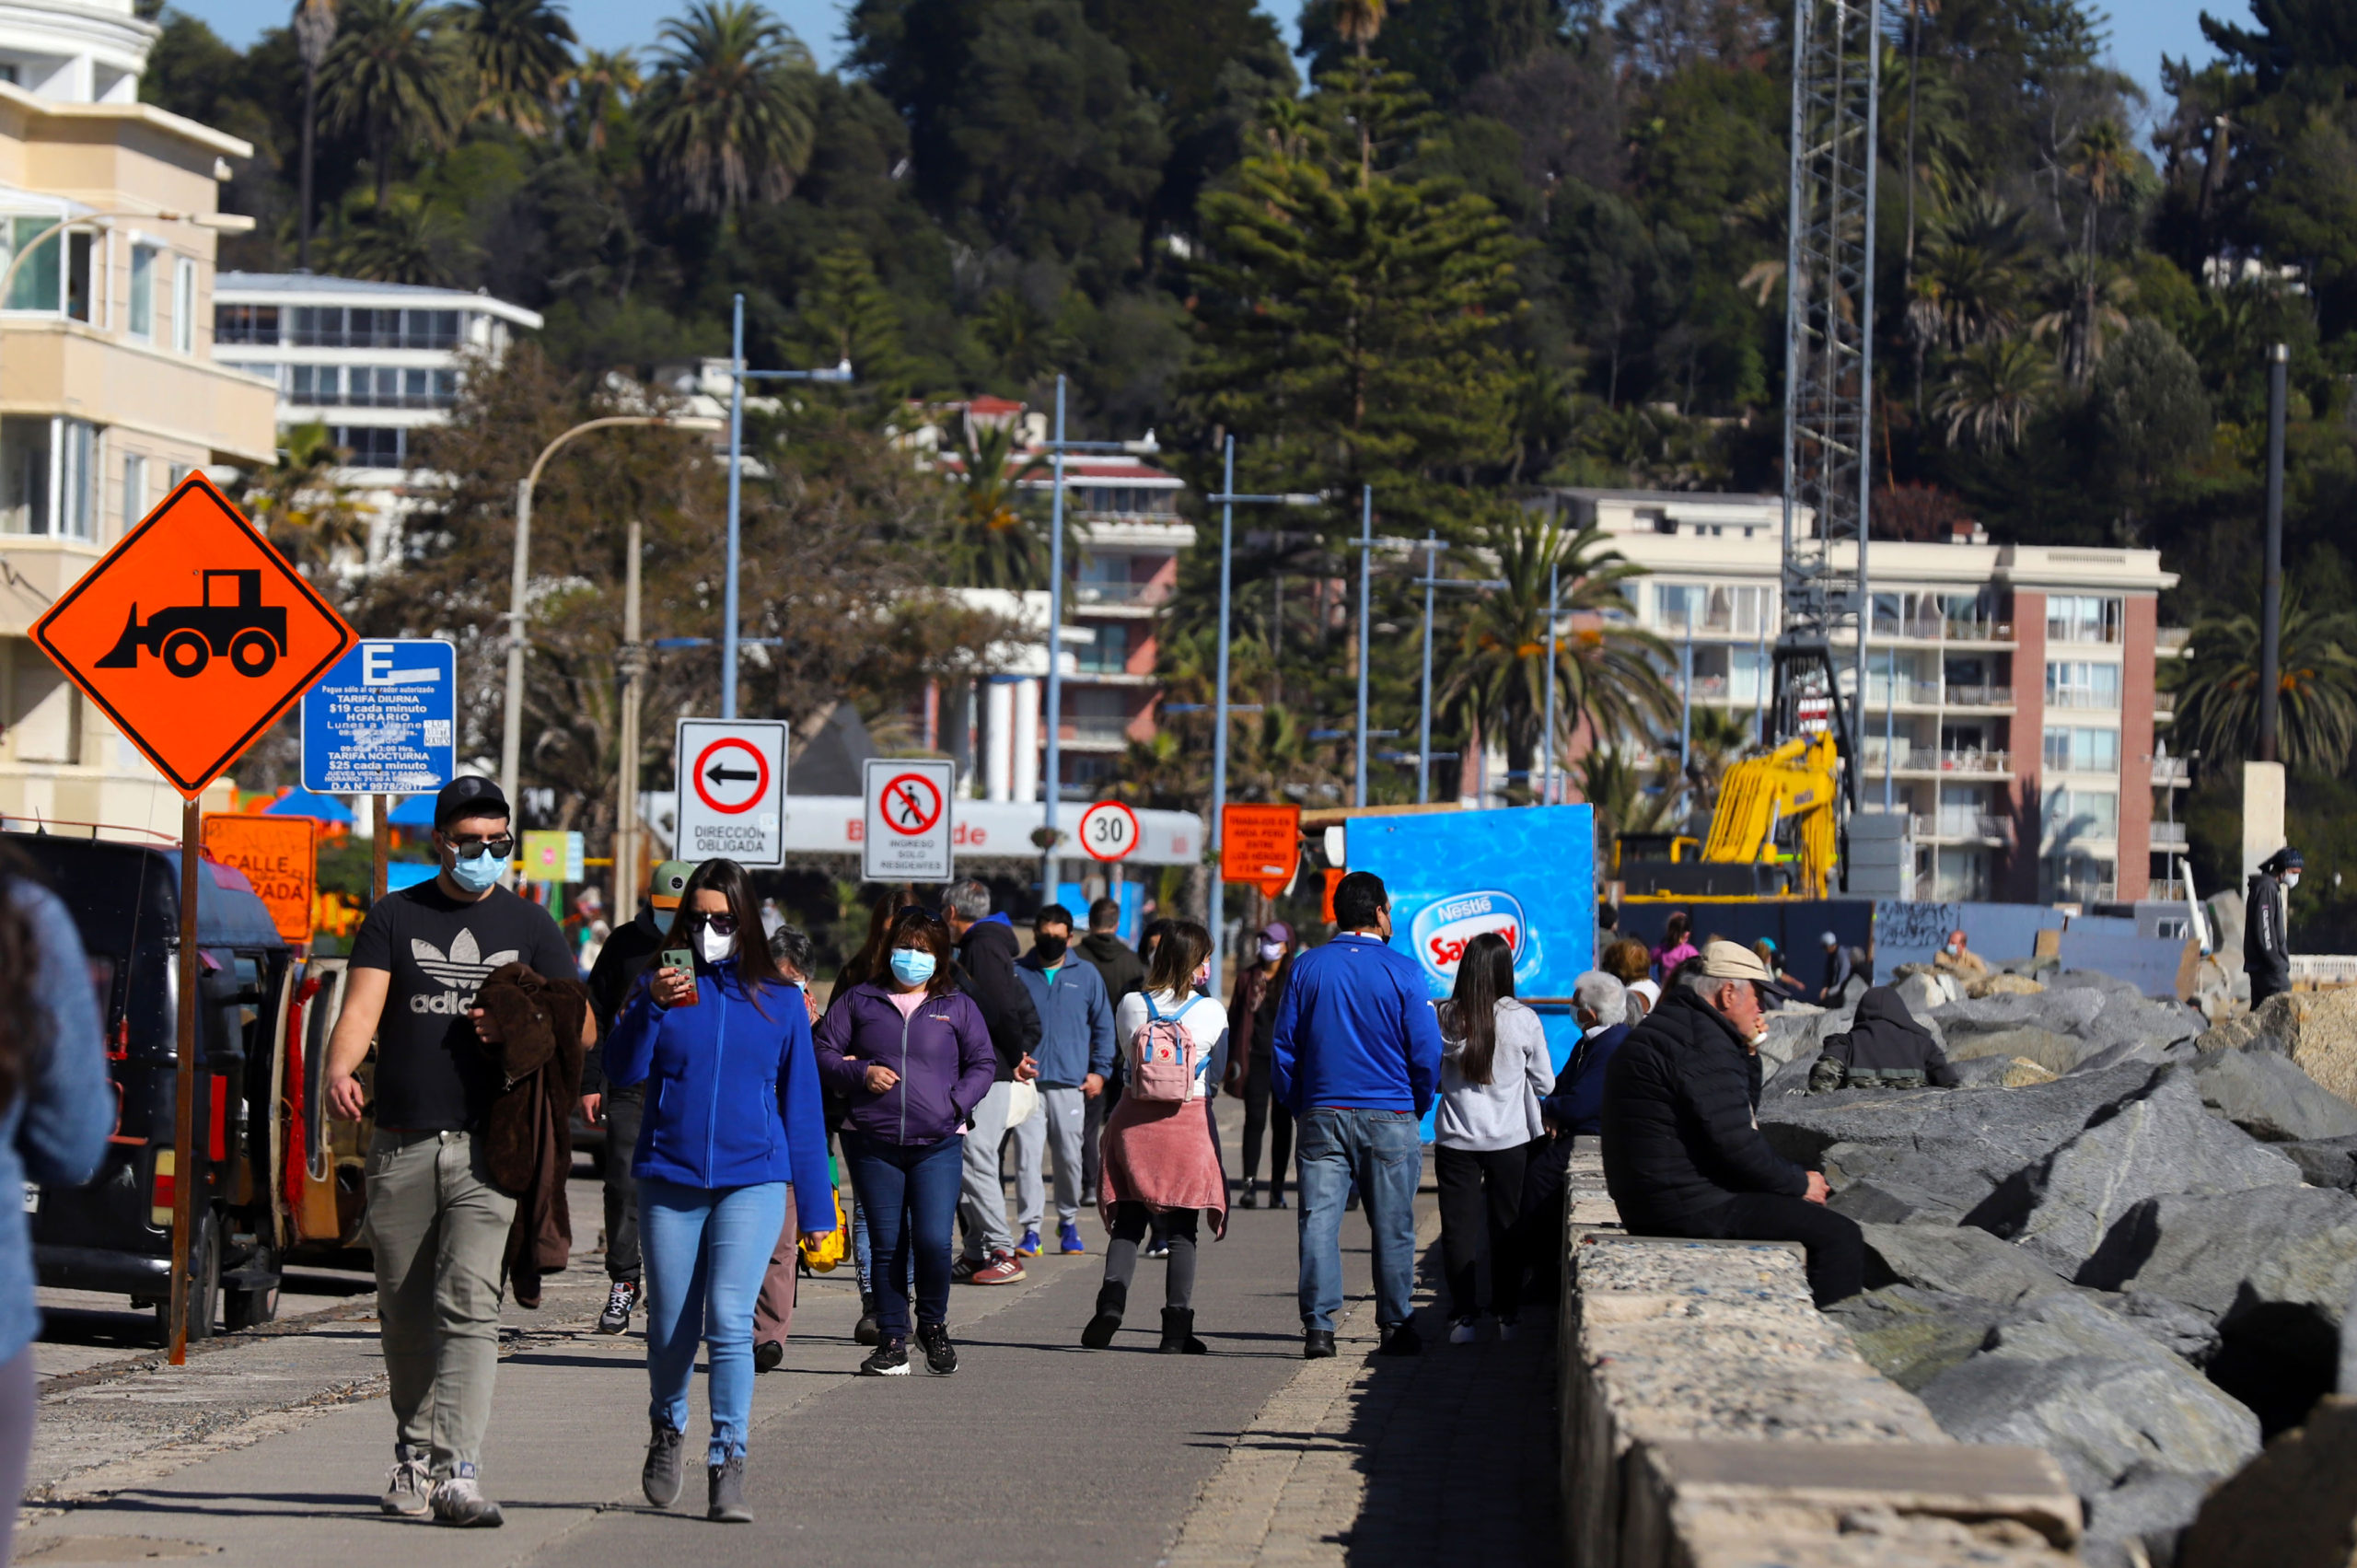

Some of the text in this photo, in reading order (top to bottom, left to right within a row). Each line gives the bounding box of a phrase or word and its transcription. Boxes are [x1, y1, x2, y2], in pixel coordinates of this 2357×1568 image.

[363, 645, 394, 685] E
[322, 686, 343, 694] Pague
[344, 685, 358, 693] sólo
[368, 686, 398, 694] operador
[330, 703, 427, 713] $19 cada minuto
[327, 721, 366, 729] Lunes
[382, 721, 423, 729] Vierne
[368, 752, 429, 761] NOCTURNA
[329, 761, 427, 770] $25 cada minuto
[1096, 817, 1122, 842] 30
[697, 839, 764, 852] OBLIGADA
[889, 840, 935, 848] INGRESO
[898, 851, 926, 859] SOLO
[224, 854, 289, 873] CALLE
[880, 860, 943, 869] RESIDENTES
[252, 882, 304, 900] RADA
[1437, 896, 1492, 923] Nestlé
[1430, 925, 1515, 965] Say
[410, 991, 477, 1016] adid
